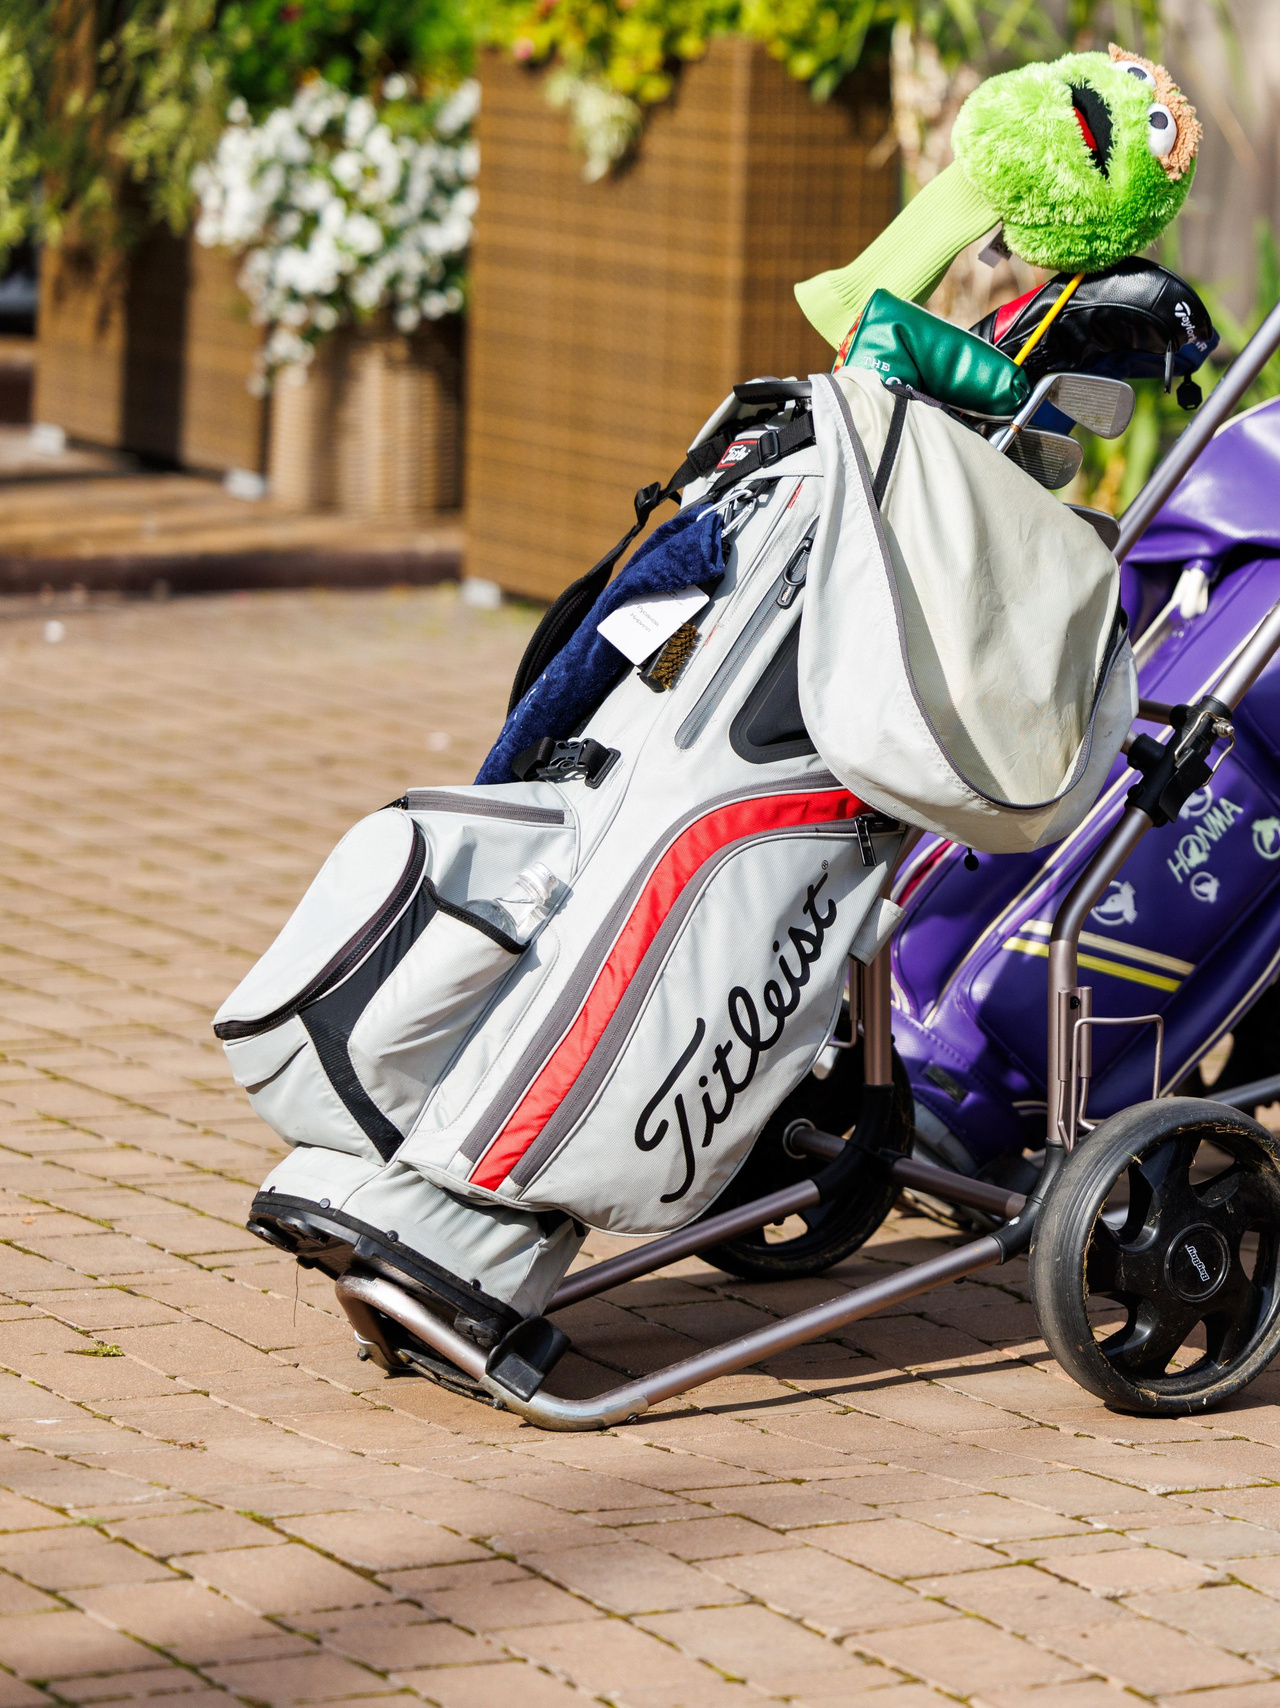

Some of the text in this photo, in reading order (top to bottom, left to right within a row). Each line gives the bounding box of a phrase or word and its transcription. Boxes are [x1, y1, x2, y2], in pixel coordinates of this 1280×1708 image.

[864, 356, 891, 373] THE
[634, 872, 838, 1204] Titleist
[1186, 1245, 1210, 1282] BagBoy
